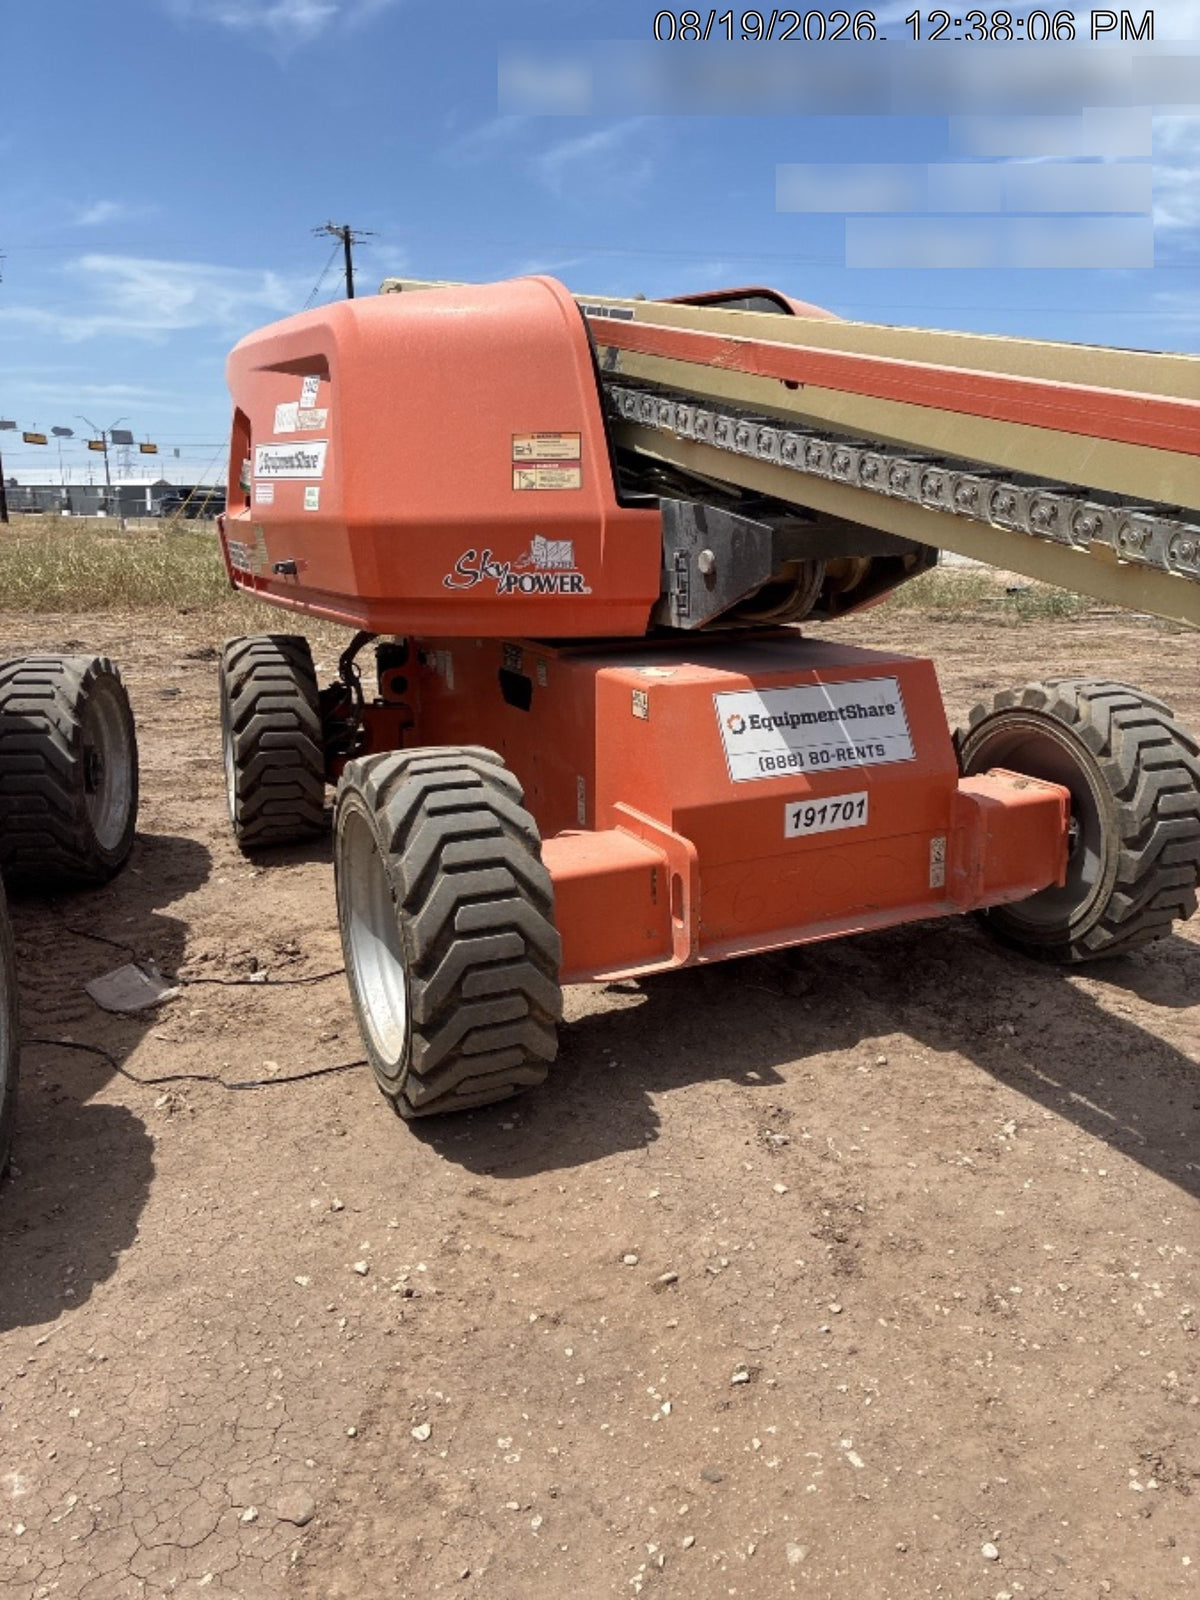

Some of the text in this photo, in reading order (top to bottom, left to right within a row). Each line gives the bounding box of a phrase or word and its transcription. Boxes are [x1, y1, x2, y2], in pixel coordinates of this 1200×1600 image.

[505, 573, 586, 594] POWER
[749, 703, 896, 731] EquipmentShare
[808, 744, 886, 766] 80-RENTS
[792, 799, 865, 829] 191701
